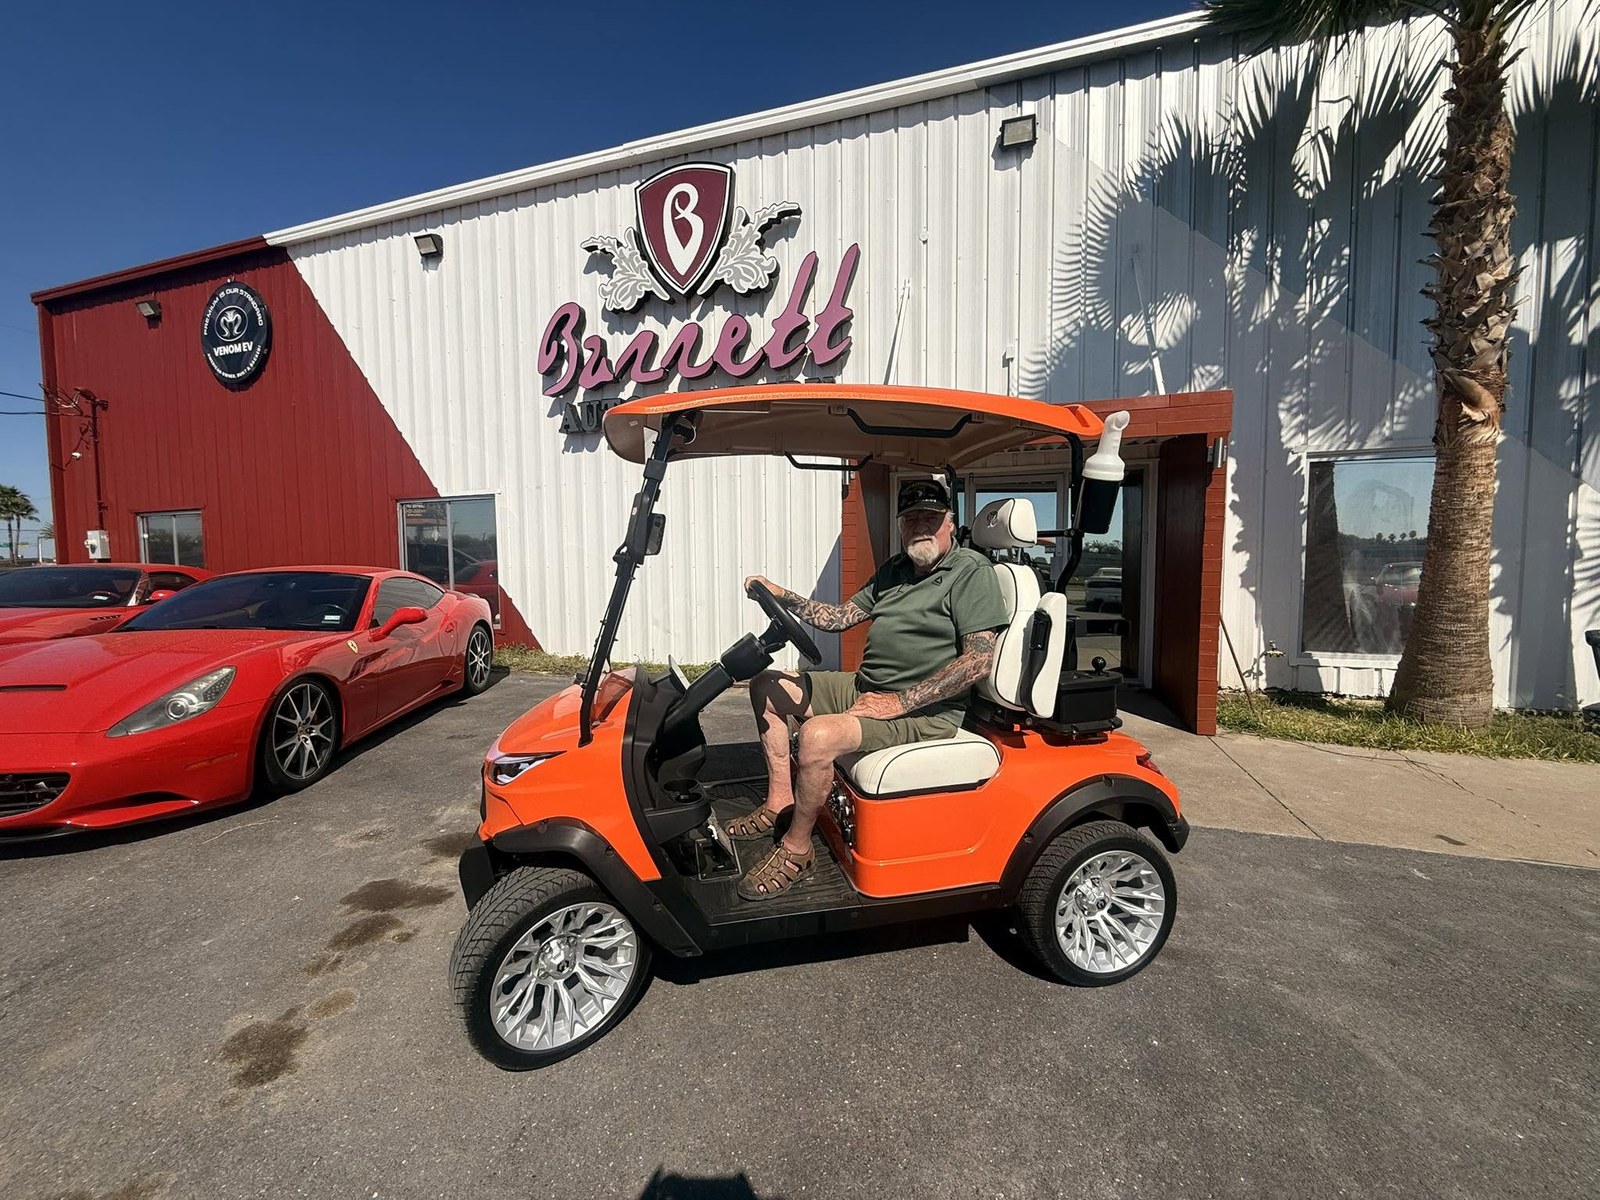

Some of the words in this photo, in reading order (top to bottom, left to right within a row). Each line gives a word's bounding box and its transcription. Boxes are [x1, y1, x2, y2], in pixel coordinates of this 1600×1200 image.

[203, 296, 220, 336] PREMIUM
[219, 291, 226, 299] IS
[225, 287, 239, 295] OUR
[239, 289, 264, 327] STANDARD
[537, 243, 859, 397] Barrett
[213, 342, 242, 357] VENOM
[242, 341, 254, 352] EV
